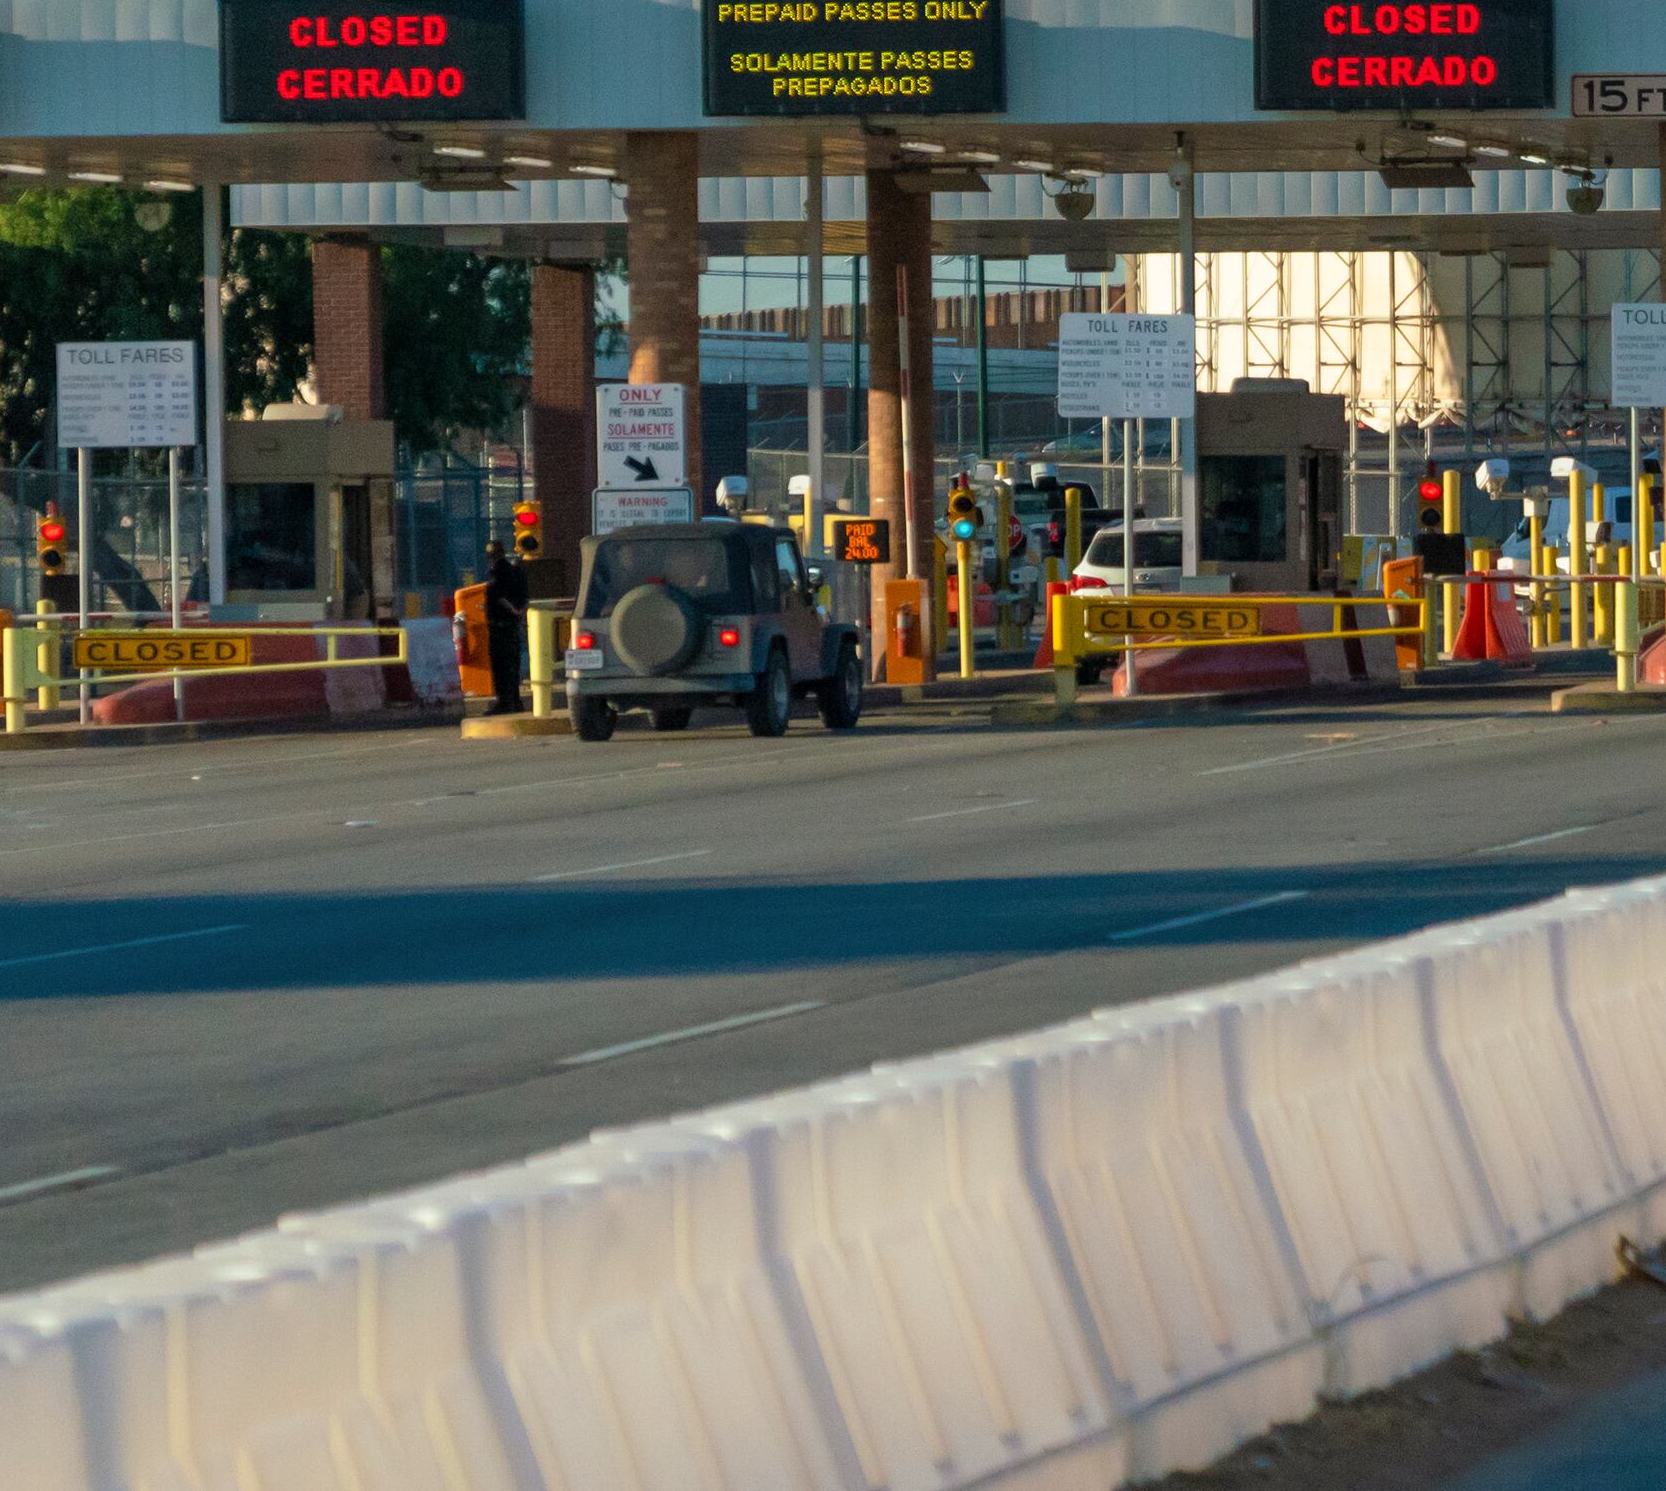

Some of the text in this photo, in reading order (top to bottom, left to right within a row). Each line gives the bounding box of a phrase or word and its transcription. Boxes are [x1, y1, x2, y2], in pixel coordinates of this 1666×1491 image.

[719, 1, 986, 22] PREPAID PASSES ONLY
[1325, 4, 1479, 34] CLOSED
[290, 16, 446, 46] CLOSED
[731, 51, 973, 72] SOLAMENTE PASSES
[1312, 56, 1495, 86] CERRADO
[278, 68, 462, 99] CERRADO
[773, 76, 931, 96] PREPAGADOS
[1584, 80, 1628, 112] 15
[1088, 320, 1167, 334] TOLL FARES
[66, 348, 184, 364] TOLL FARES
[620, 389, 662, 402] ONLY
[648, 407, 674, 417] PASSES
[607, 423, 675, 436] SOLAMENTE
[619, 497, 668, 507] WARNING
[846, 523, 875, 536] PAID
[849, 536, 871, 547] BAL
[1100, 610, 1248, 630] CLOSED
[87, 641, 238, 662] CLOSED
